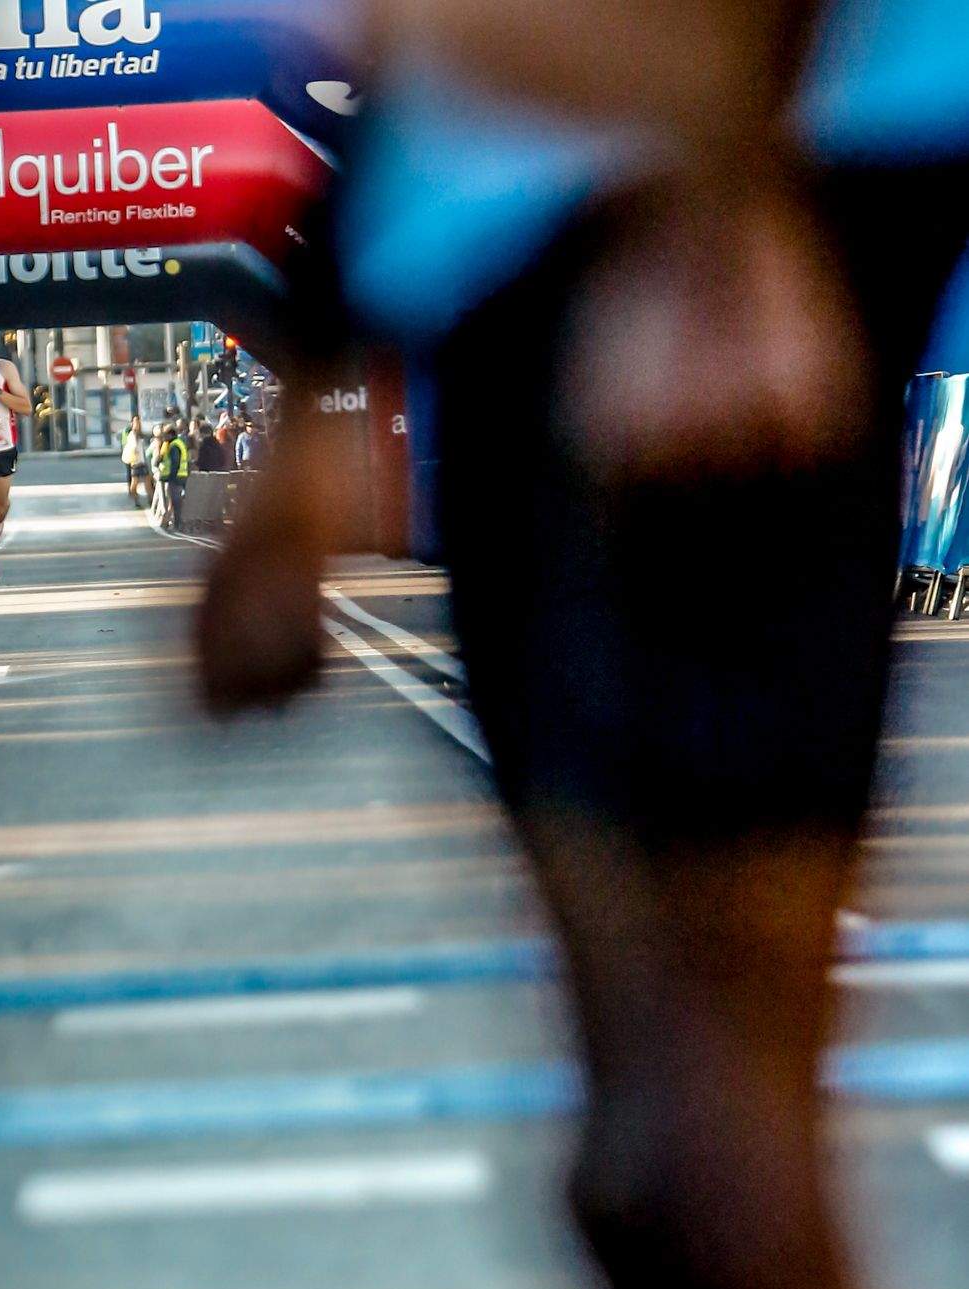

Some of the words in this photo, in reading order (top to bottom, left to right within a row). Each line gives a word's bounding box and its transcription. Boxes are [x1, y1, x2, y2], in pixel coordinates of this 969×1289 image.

[15, 55, 45, 80] tu
[49, 50, 160, 78] libertad
[51, 207, 120, 225] Renting
[126, 202, 196, 220] Flexible
